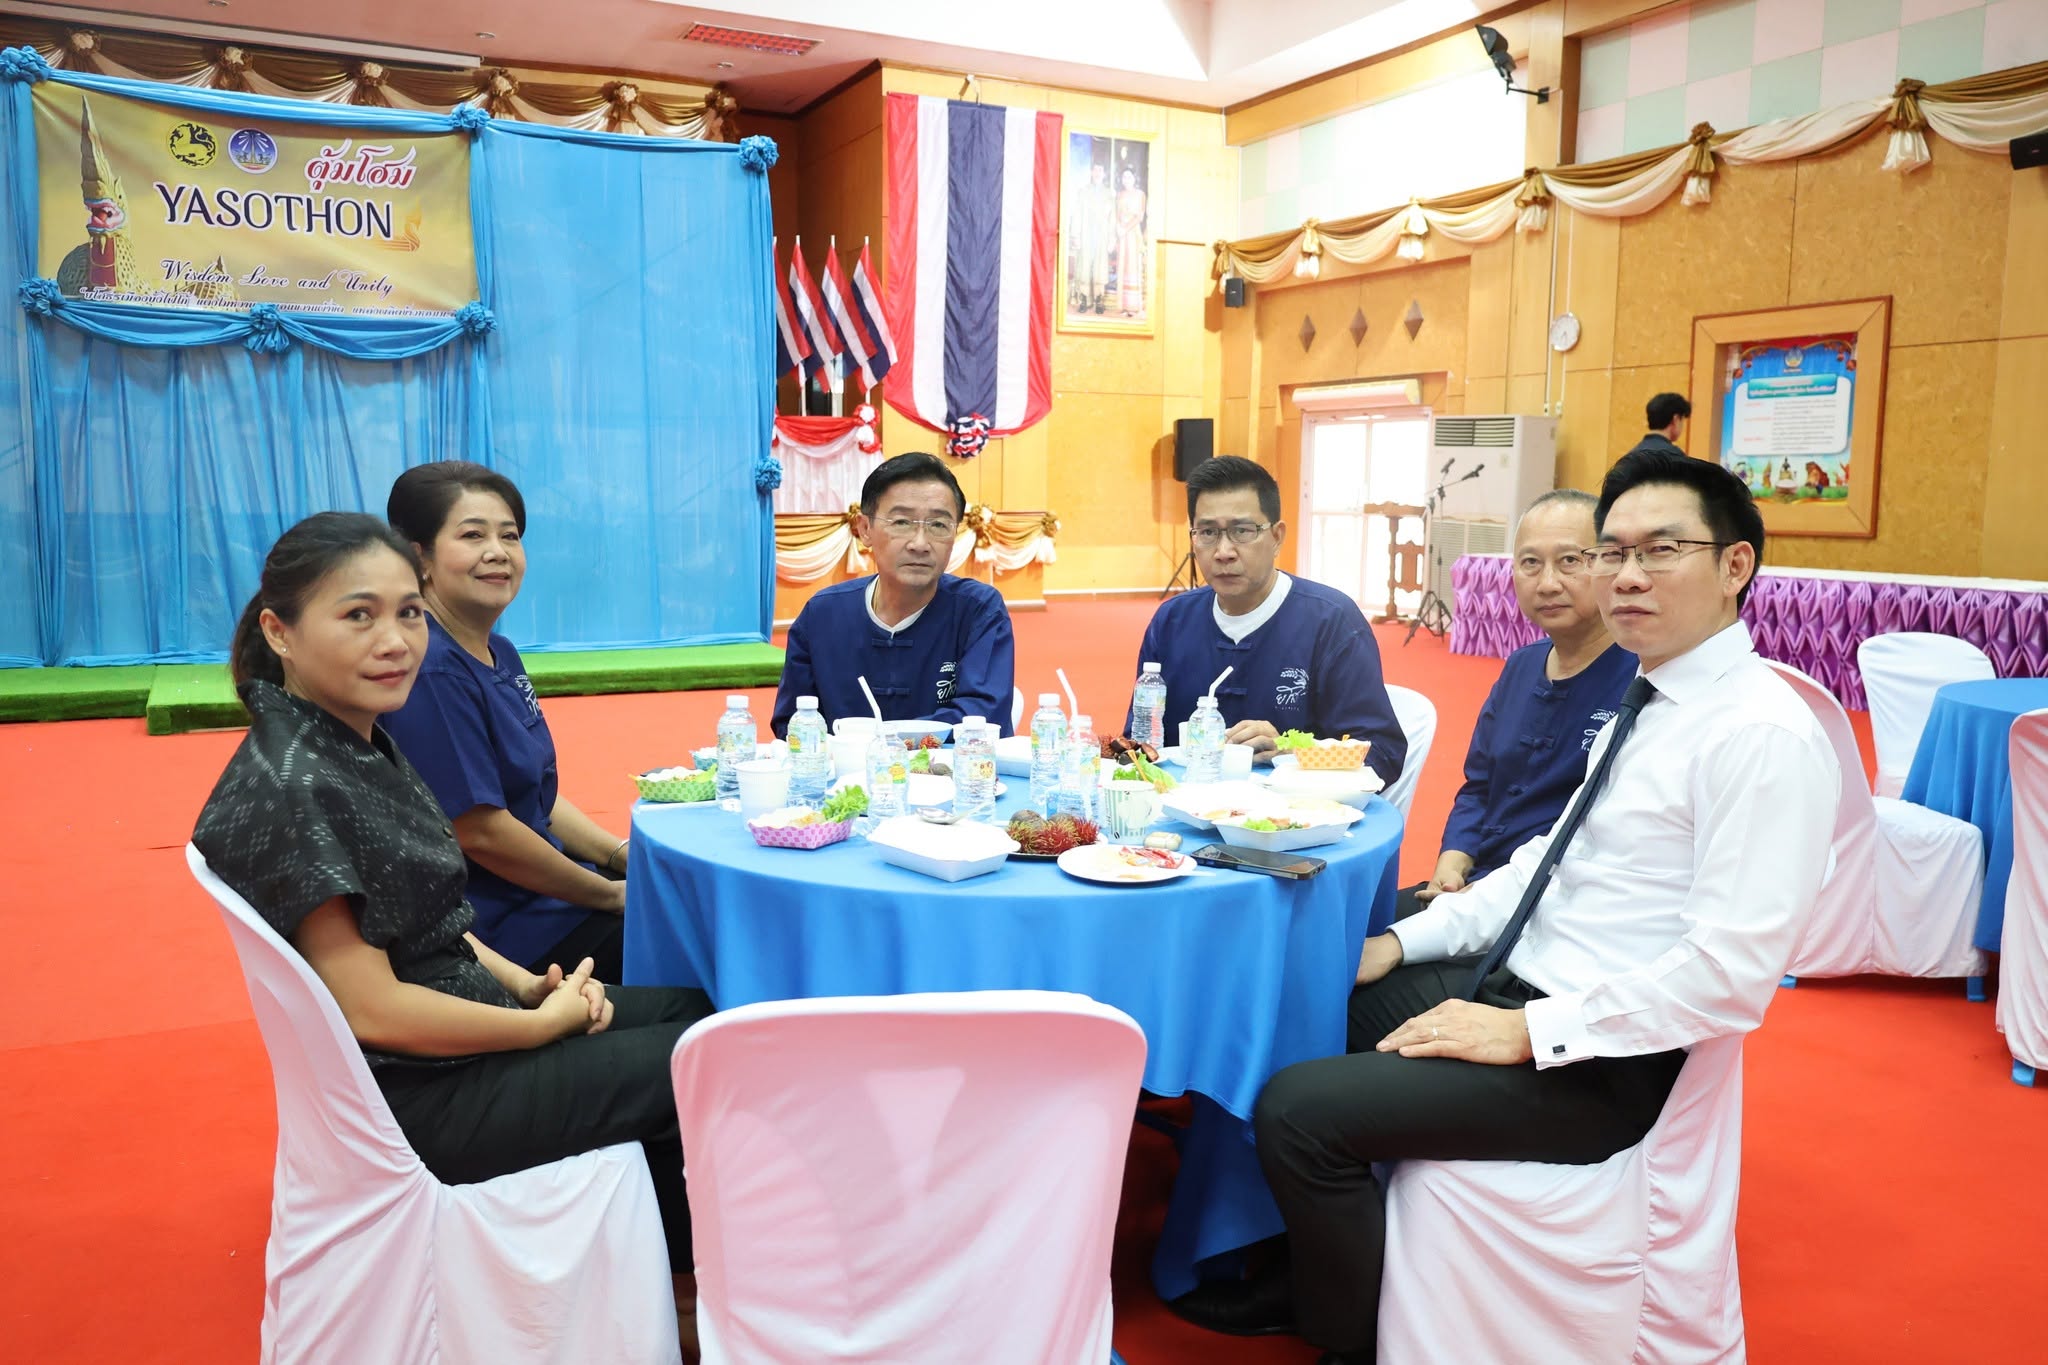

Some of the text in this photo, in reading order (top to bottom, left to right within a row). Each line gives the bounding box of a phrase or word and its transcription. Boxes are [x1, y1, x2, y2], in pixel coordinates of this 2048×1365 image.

[306, 142, 415, 191] ตุ้มโฮม
[155, 184, 391, 238] YASOTHON
[161, 259, 395, 298] Wisdom Love and Unity
